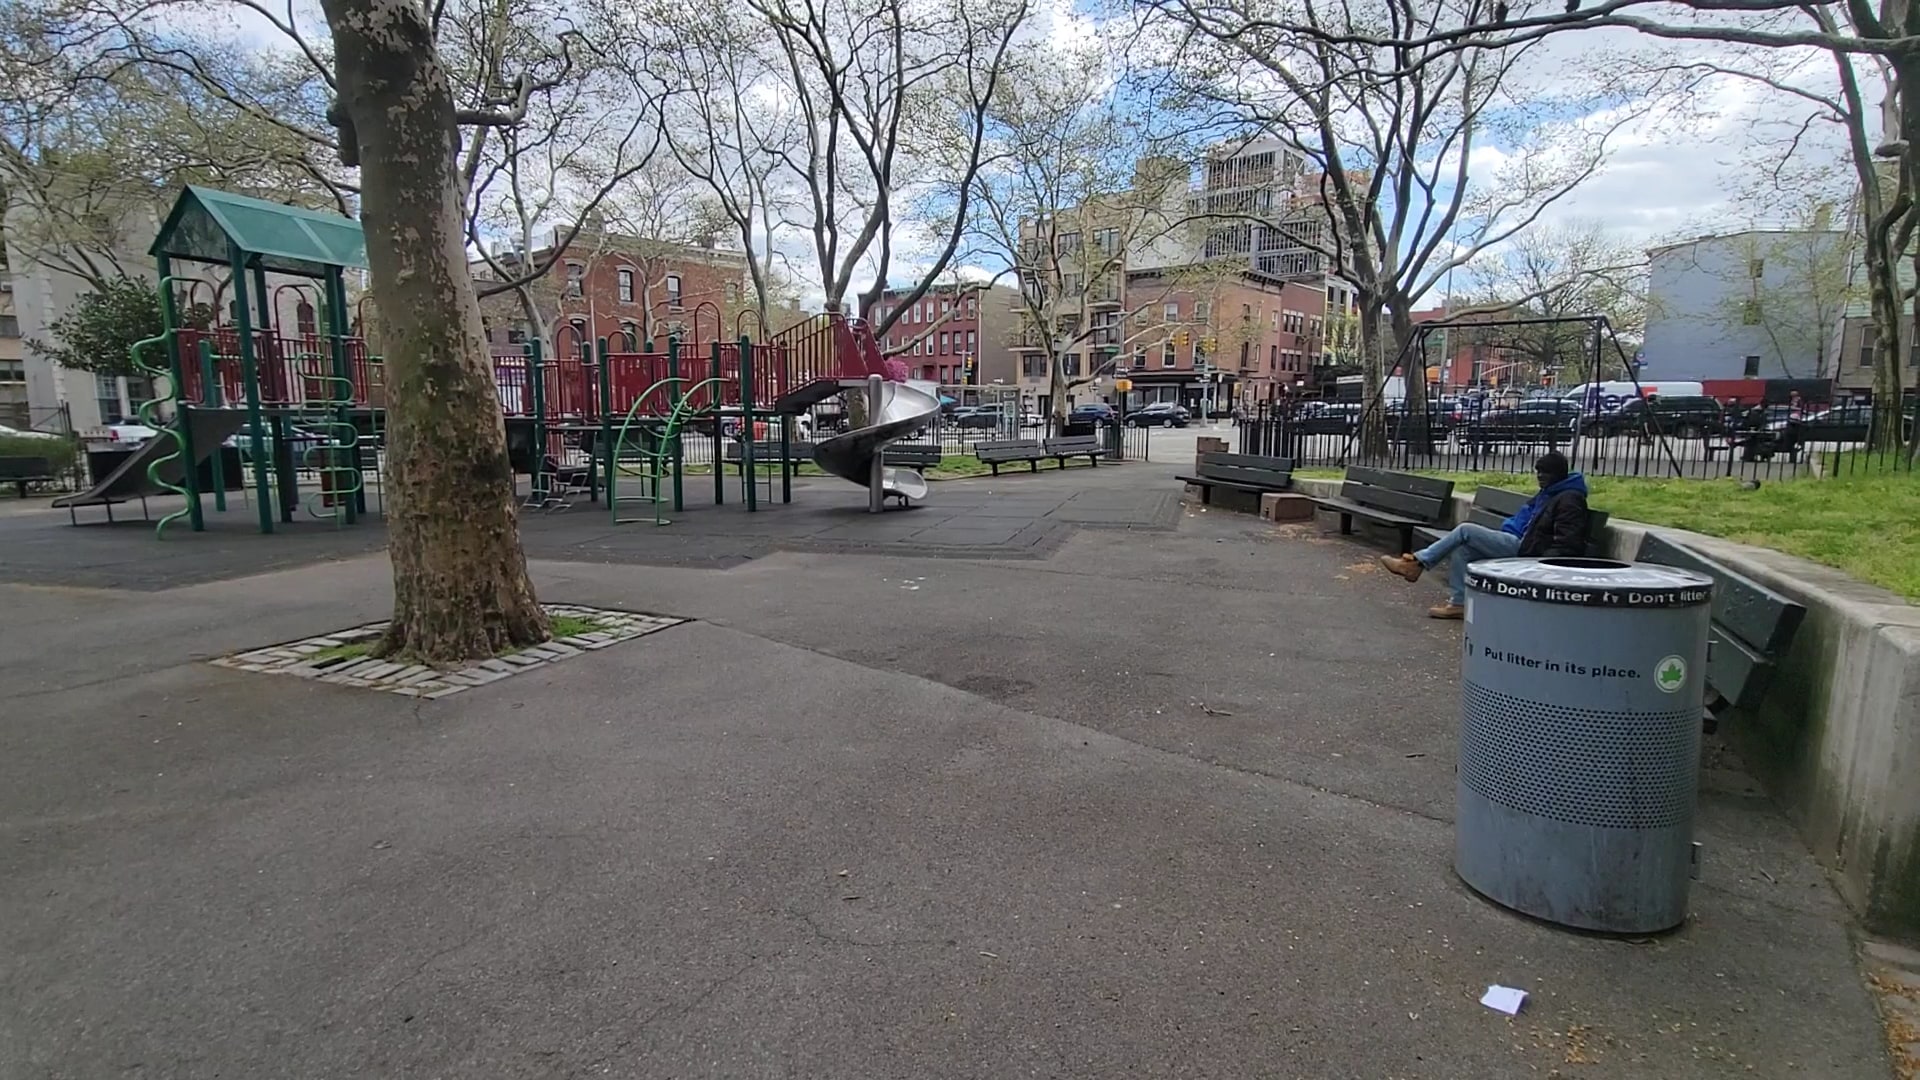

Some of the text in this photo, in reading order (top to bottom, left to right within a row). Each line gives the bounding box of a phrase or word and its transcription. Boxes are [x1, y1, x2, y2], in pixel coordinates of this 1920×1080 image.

[1588, 386, 1658, 410] Fed
[1497, 582, 1539, 599] Don't
[1545, 587, 1592, 602] litter
[1628, 591, 1675, 604] Don't
[1484, 647, 1641, 679] Put litter in its place.
